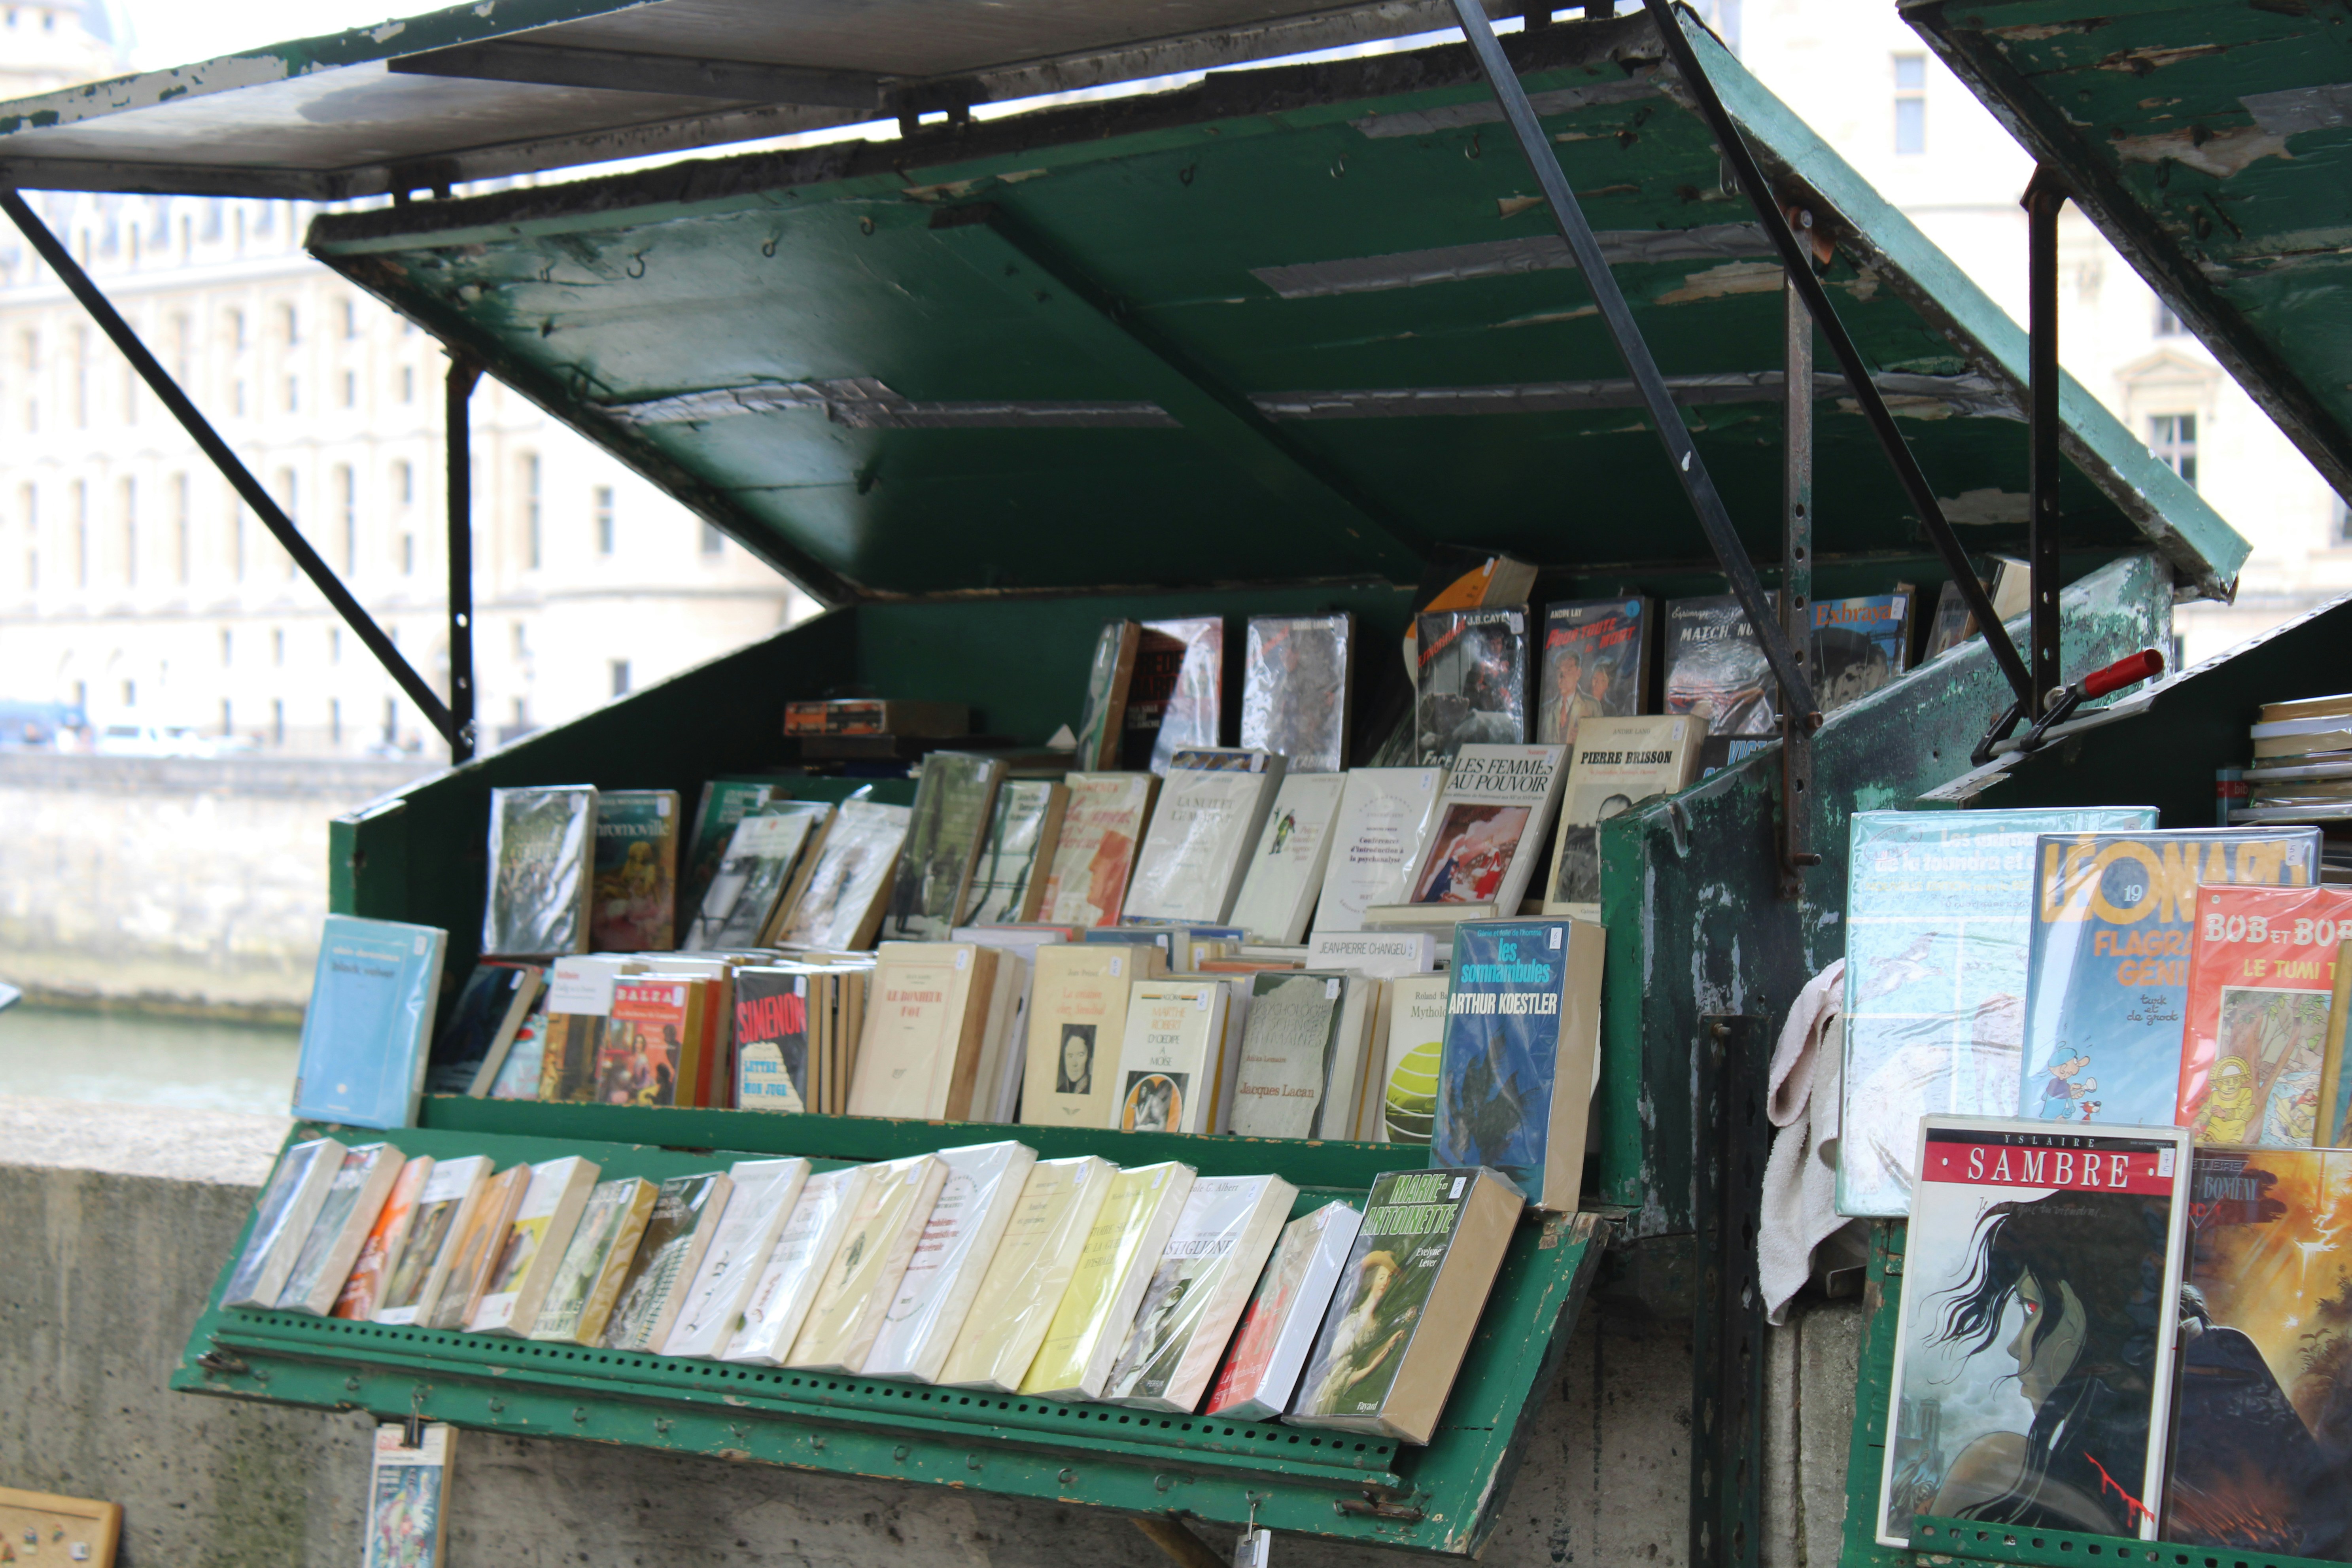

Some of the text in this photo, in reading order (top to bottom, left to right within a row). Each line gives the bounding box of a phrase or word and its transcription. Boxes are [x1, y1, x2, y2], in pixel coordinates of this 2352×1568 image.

[1815, 601, 1892, 626] Exbraya
[1599, 626, 1636, 649] MORT
[1681, 623, 1729, 641] MATCH
[1423, 751, 1452, 766] FACE
[1581, 751, 1673, 764] PIERRE BRISSON
[1455, 758, 1485, 773] LES
[1448, 774, 1548, 792] AU POUVOIR
[2235, 783, 2248, 795] bib
[1359, 836, 1400, 845] Conférences
[1941, 825, 2036, 848] Les anima
[1875, 849, 2023, 872] de la toundra et
[2124, 885, 2142, 902] 19
[1520, 929, 1542, 937] l'homme
[2205, 913, 2291, 944] BOB ET
[1320, 942, 1407, 955] JEAN-PIERRE CHANGEU
[1498, 938, 1517, 961] les
[2094, 929, 2193, 957] FLAGRA
[1461, 959, 1550, 984] somnambules
[2117, 956, 2191, 987] GÉNI
[2244, 958, 2336, 980] LE TUMI T
[616, 988, 673, 1003] BALZA
[887, 990, 943, 1002] LE BONHEUR
[1063, 987, 1073, 999] La
[1163, 993, 1182, 1001] AGORA
[2140, 994, 2167, 1006] turk
[1254, 1002, 1328, 1018] PSYCHOLOGIE
[1448, 993, 1558, 1015] ARTHUR KOESTLER
[2144, 1006, 2159, 1014] et
[737, 992, 807, 1044] SIMENON
[1152, 1006, 1187, 1018] MARTHE
[1410, 1006, 1448, 1020] Mytholo
[2126, 1012, 2179, 1027] de groot
[1151, 1019, 1182, 1030] ROBERT
[1253, 1017, 1325, 1033] ET SCIENCES
[1250, 1030, 1322, 1047] HUMAINES
[744, 1083, 788, 1096] MON JUGE
[1240, 1082, 1314, 1099] Jacques Lacan
[2004, 1135, 2095, 1148] YSLAIRE
[1968, 1147, 2129, 1188] SAMBRE
[2201, 1160, 2243, 1172] LIBRE
[1215, 1182, 1239, 1192] Albert
[1389, 1173, 1449, 1205] MARIE-
[1975, 1196, 1988, 1220] Je
[2016, 1202, 2036, 1218] que
[2039, 1203, 2052, 1214] tu
[1359, 1203, 1459, 1237] ANTOINETTE
[1416, 1246, 1442, 1258] Evelyne
[1418, 1258, 1438, 1268] Lever
[1356, 1401, 1378, 1411] Fayard
